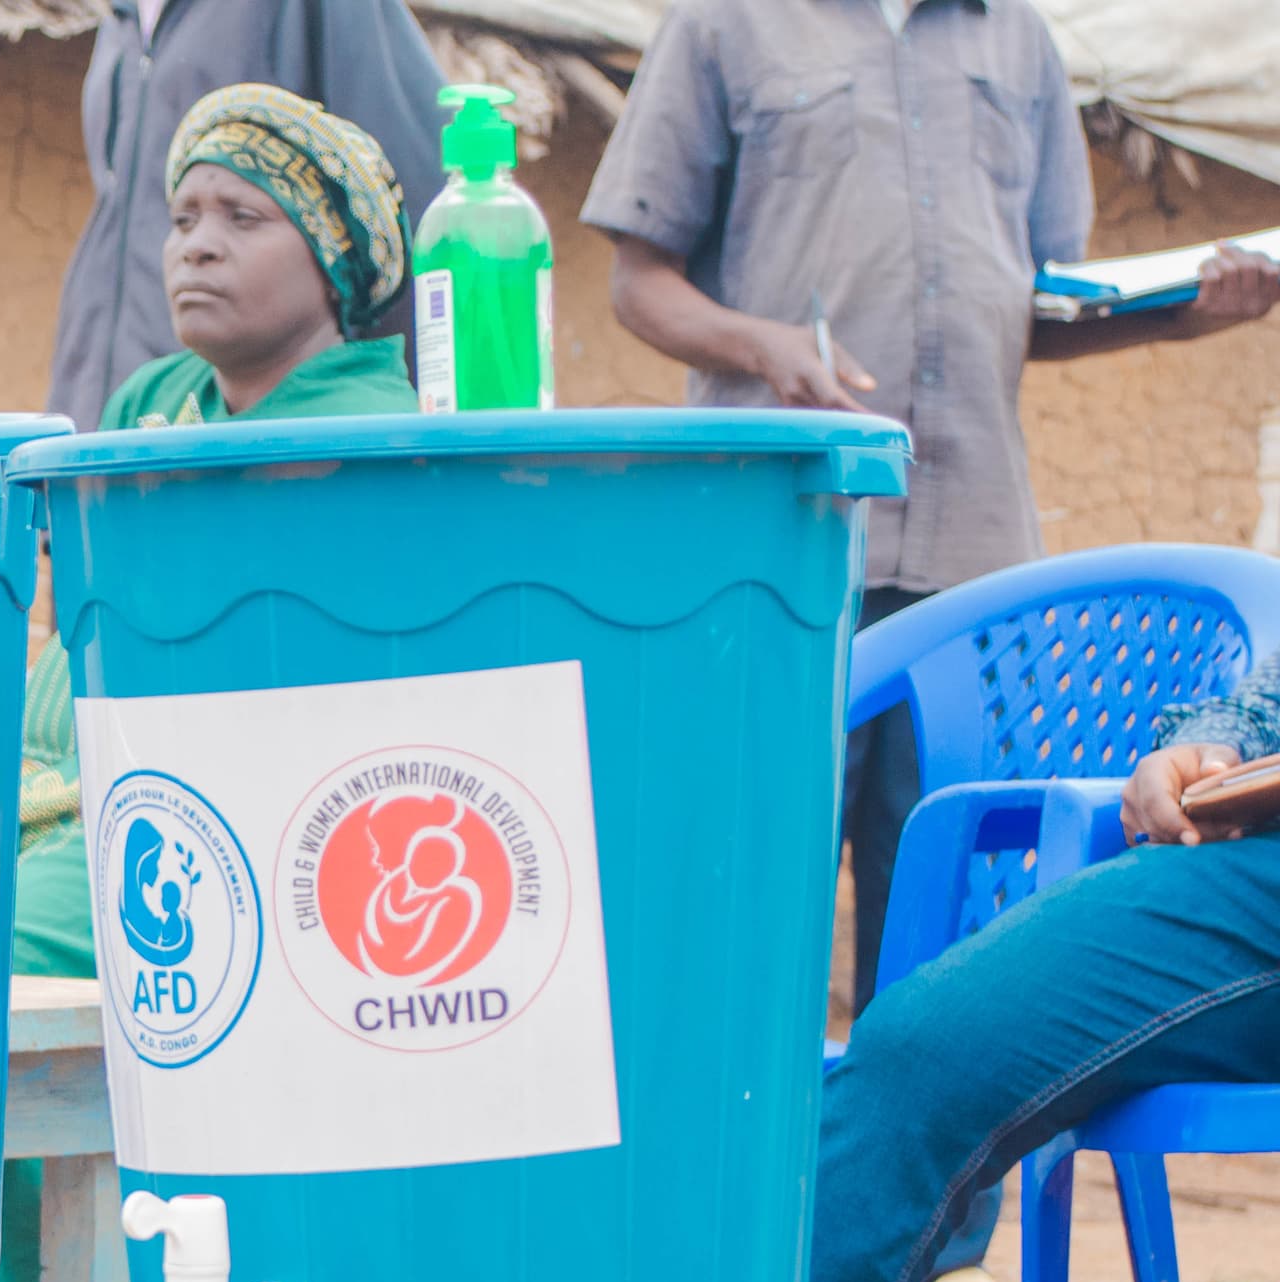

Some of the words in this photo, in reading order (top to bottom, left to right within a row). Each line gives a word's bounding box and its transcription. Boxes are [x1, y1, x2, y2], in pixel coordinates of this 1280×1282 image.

[344, 761, 485, 804] INTERNATIONAL
[298, 789, 350, 854] WOMEN
[481, 791, 542, 917] DEVELOPMENT
[293, 877, 319, 931] CHILD
[134, 970, 198, 1015] AFD
[354, 987, 509, 1033] CHWID
[160, 1033, 198, 1052] CONGO
